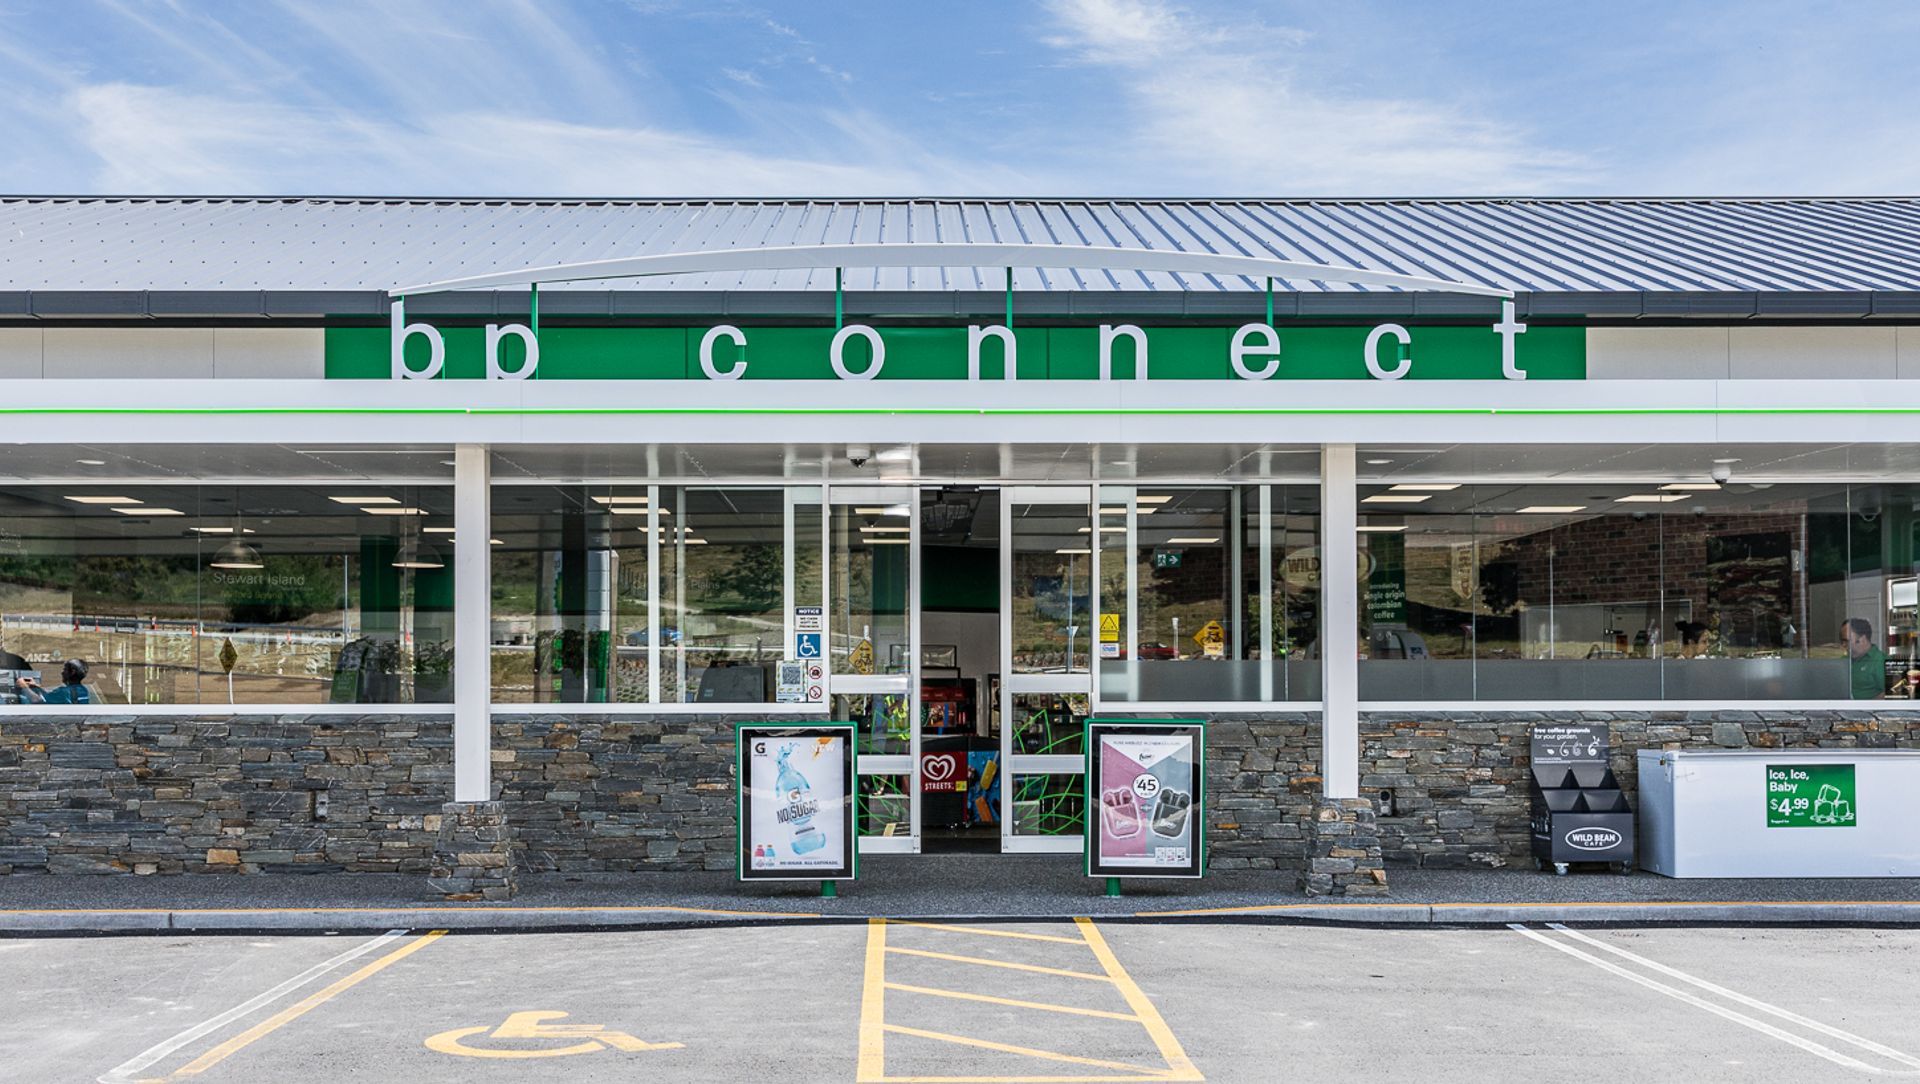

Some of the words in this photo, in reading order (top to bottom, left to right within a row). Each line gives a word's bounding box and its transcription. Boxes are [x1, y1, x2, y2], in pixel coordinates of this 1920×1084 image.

[391, 301, 539, 380] bp
[700, 301, 1527, 380] connect
[213, 572, 263, 584] Stewart
[268, 572, 305, 586] Island
[1384, 590, 1405, 600] origin
[1366, 600, 1402, 610] colombian
[1373, 610, 1395, 619] coffee
[25, 653, 51, 662] ANZ
[1566, 727, 1591, 735] grounds
[754, 742, 766, 754] G
[1769, 769, 1788, 780] Ice,
[1790, 769, 1810, 780] Ice,
[925, 781, 951, 790] STREETS
[1769, 781, 1798, 794] Baby
[1770, 798, 1809, 816] $4.99
[776, 808, 790, 824] NO
[1572, 834, 1593, 842] WILD
[1594, 834, 1616, 842] BEAN
